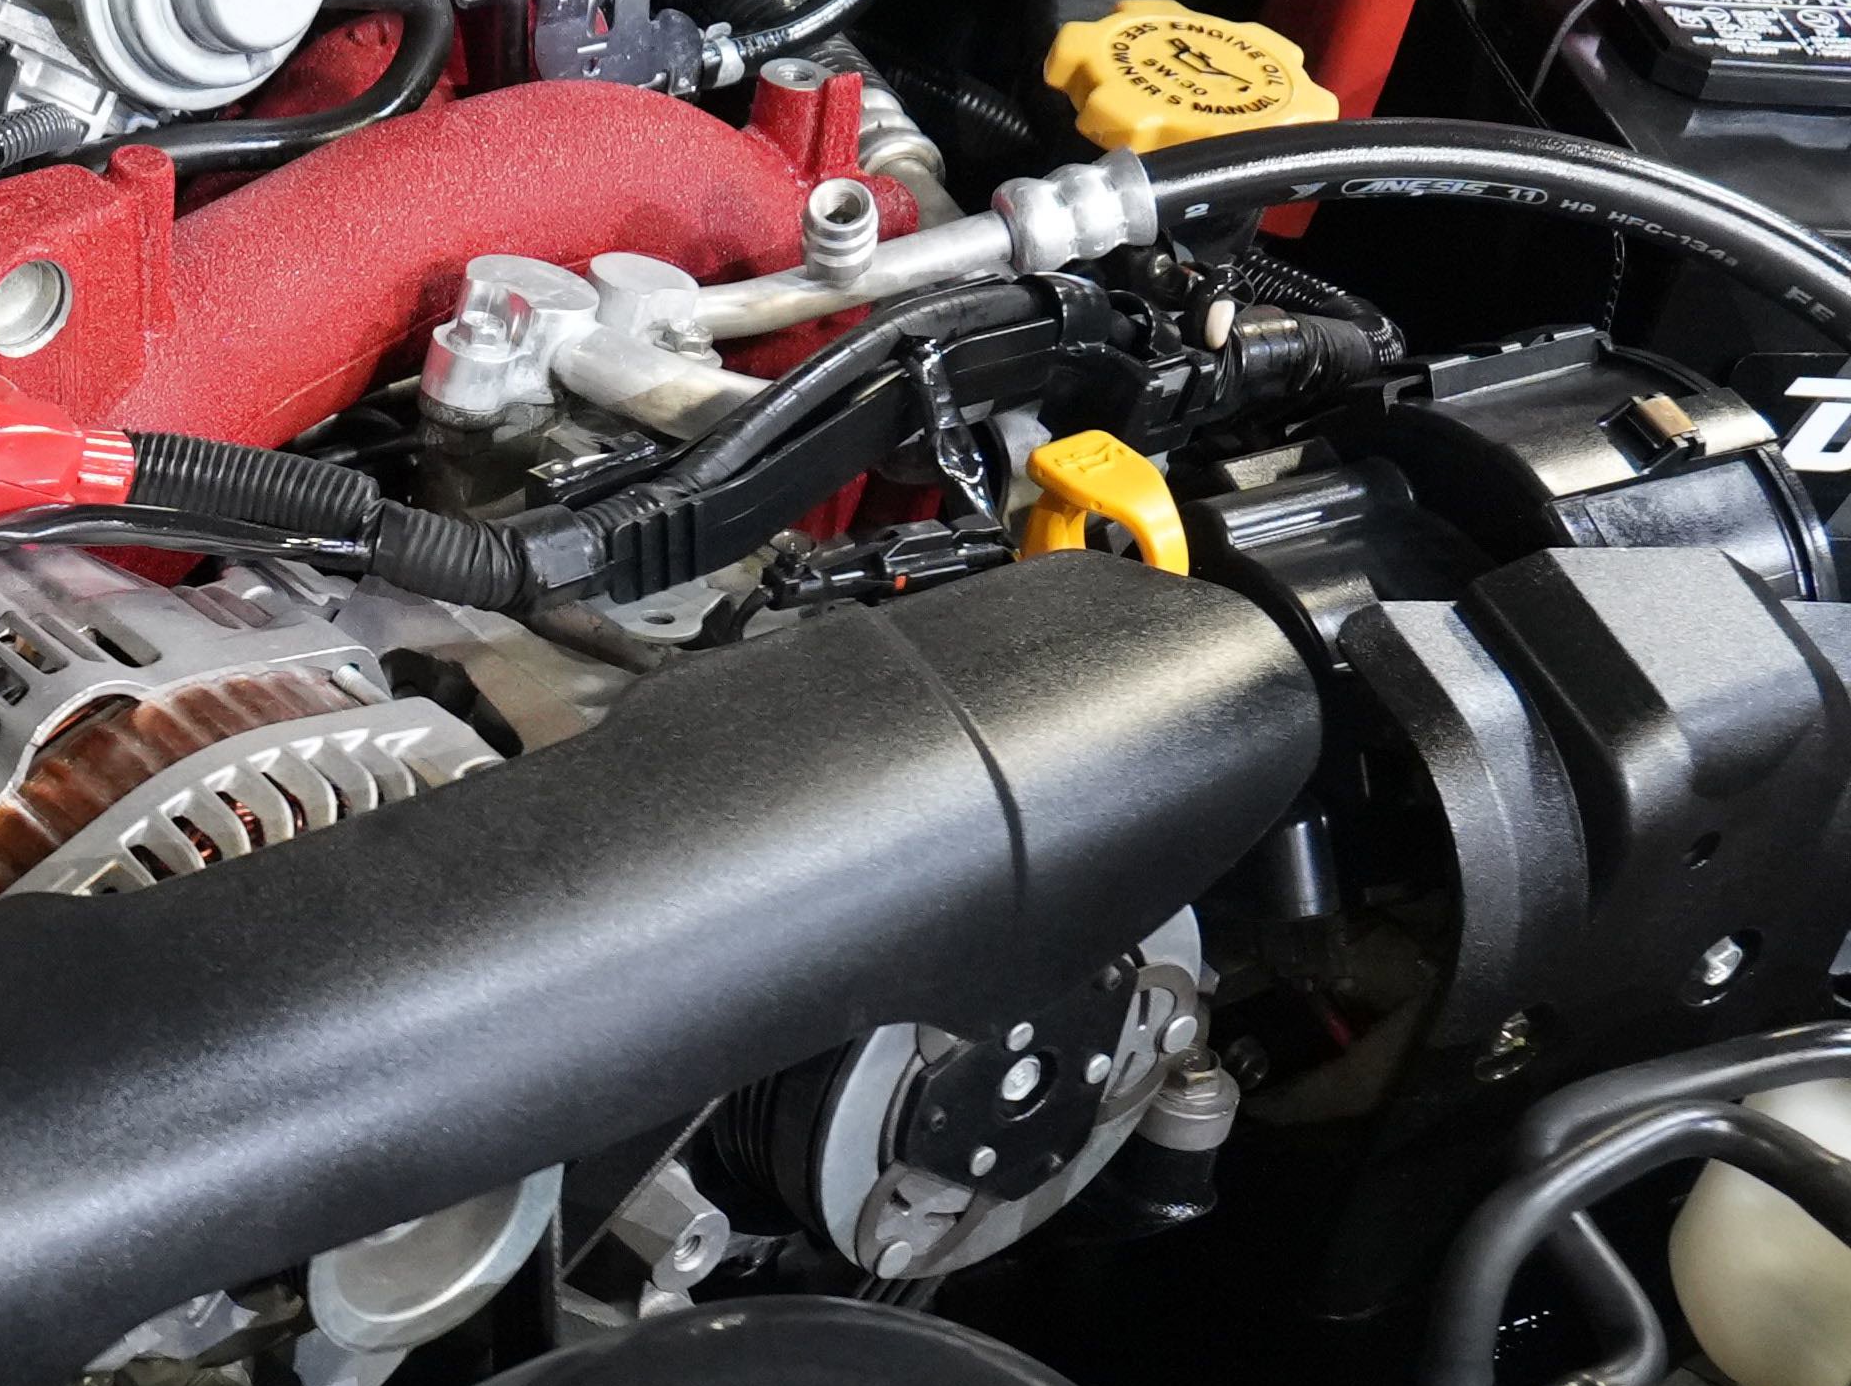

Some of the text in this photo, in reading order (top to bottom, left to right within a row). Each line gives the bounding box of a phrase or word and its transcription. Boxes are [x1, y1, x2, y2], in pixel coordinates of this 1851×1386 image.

[1117, 21, 1159, 41] SEE
[1191, 95, 1281, 115] MANUAL
[1169, 21, 1286, 87] ENGINE OIL
[1184, 202, 1211, 220] 2
[1507, 187, 1538, 202] 11
[1558, 198, 1597, 213] HP
